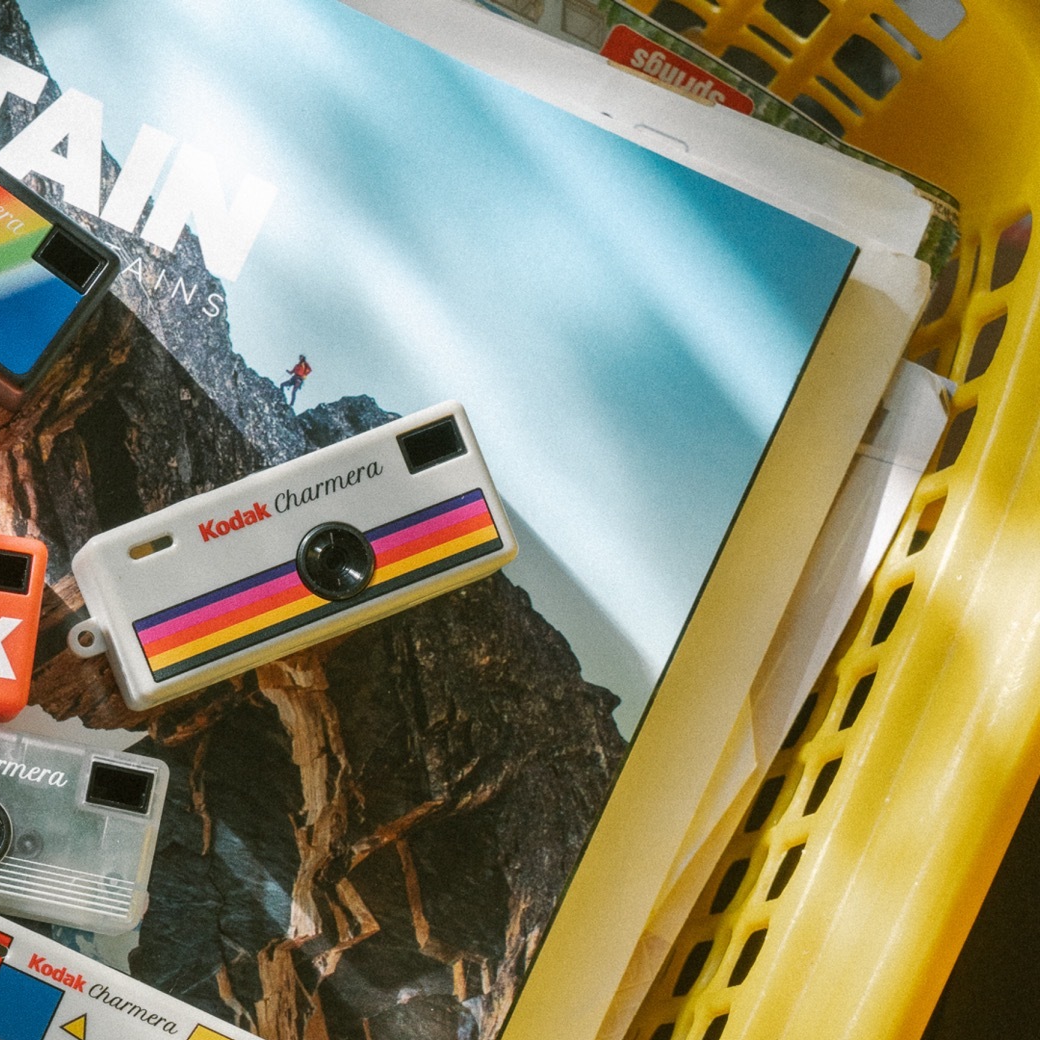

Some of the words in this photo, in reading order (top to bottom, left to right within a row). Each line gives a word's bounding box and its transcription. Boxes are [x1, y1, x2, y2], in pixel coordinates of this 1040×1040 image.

[198, 502, 272, 543] Kodak
[274, 461, 384, 513] Charmera
[27, 953, 87, 993] Kodak
[88, 983, 179, 1035] Charmera
